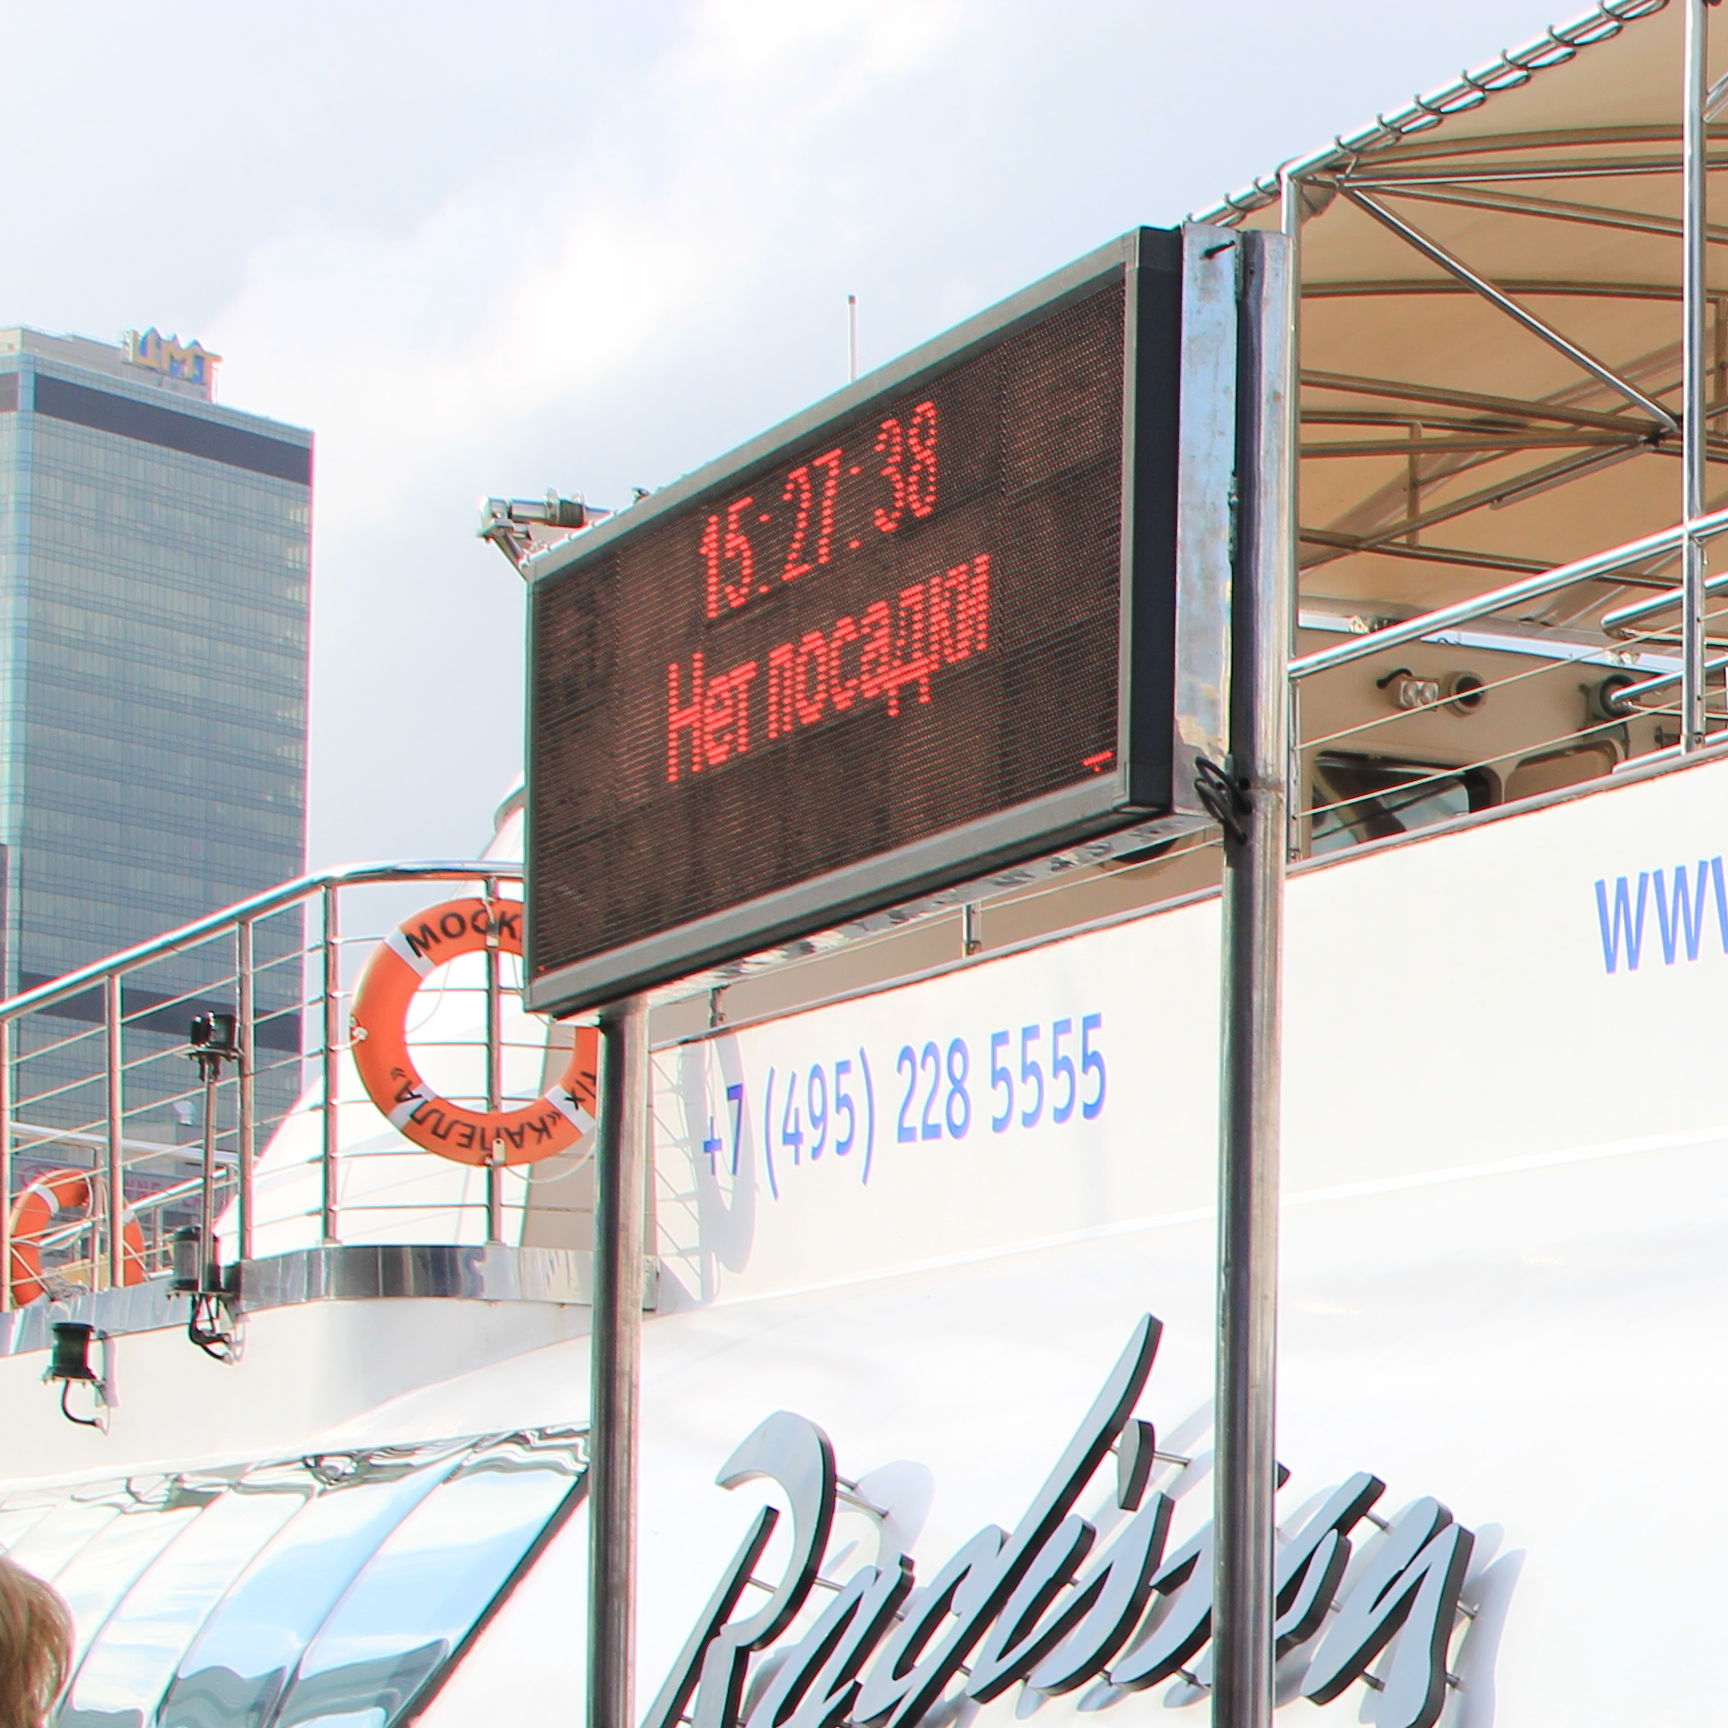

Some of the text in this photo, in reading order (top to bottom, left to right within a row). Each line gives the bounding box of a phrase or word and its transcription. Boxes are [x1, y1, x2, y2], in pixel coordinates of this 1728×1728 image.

[700, 401, 938, 618] 15:27:38
[668, 553, 992, 783] Нет посадки
[703, 1011, 1108, 1201] +7 (495) 228 5555
